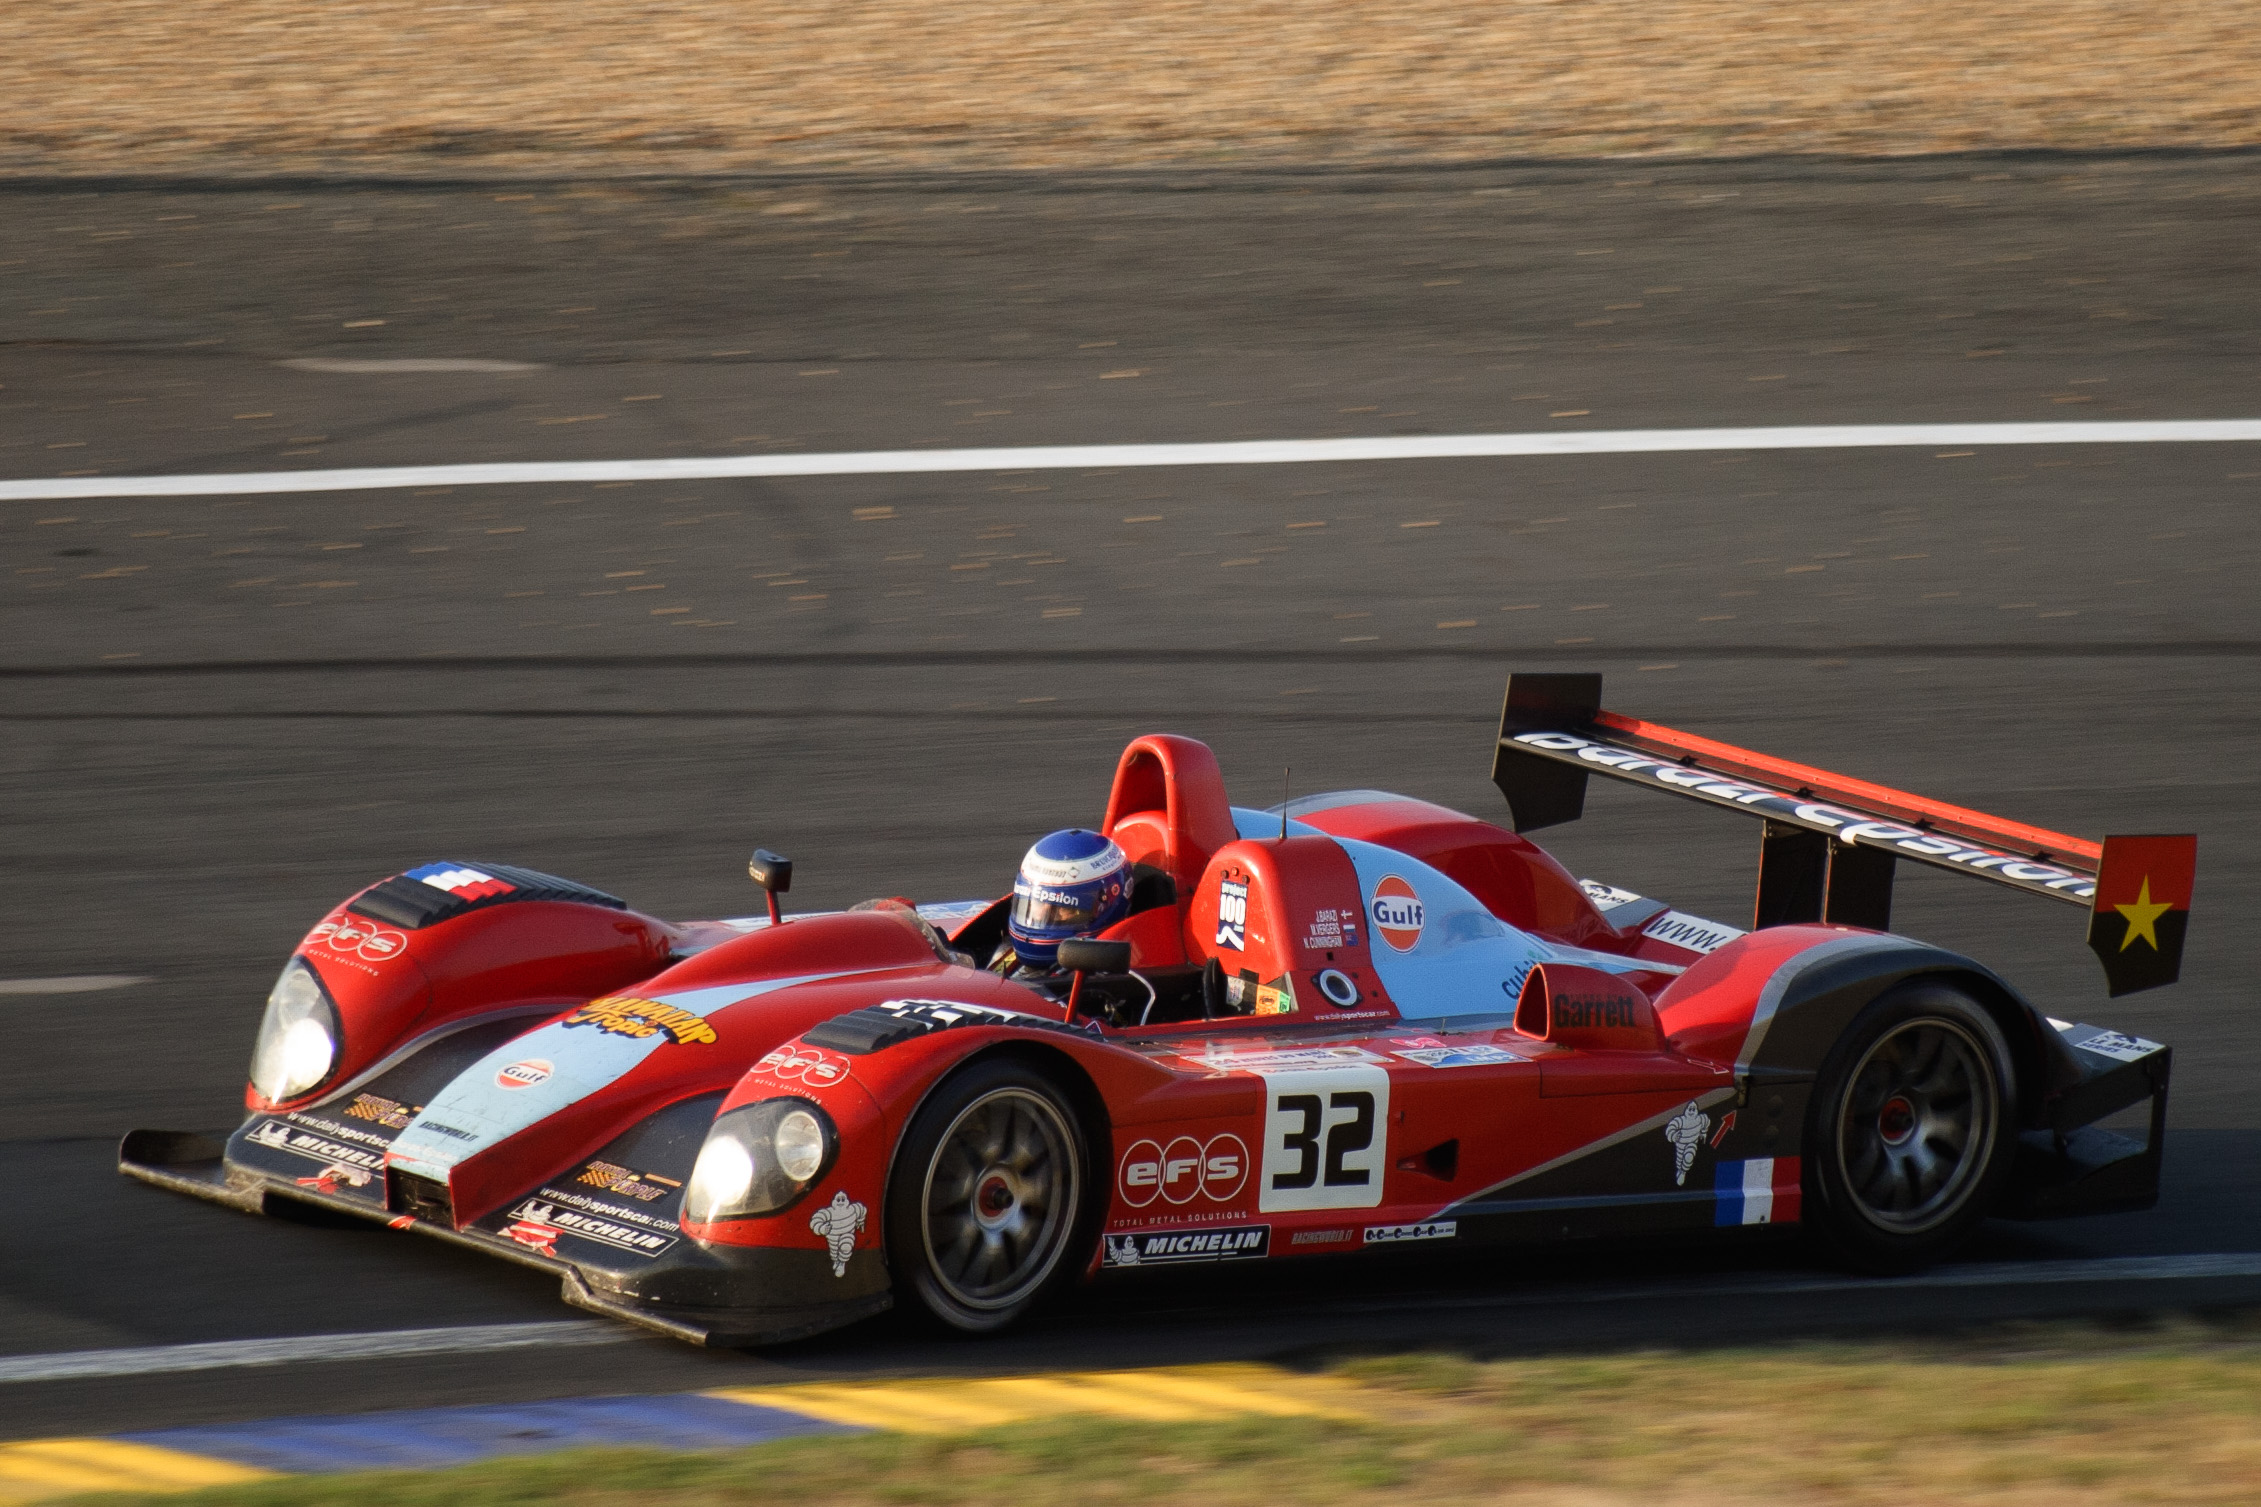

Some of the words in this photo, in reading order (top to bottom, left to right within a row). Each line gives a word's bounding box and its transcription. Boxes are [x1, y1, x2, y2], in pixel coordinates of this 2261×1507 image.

[1219, 894, 1246, 925] 100
[1373, 901, 1423, 926] Gulf
[1554, 993, 1636, 1028] Garrett
[503, 1066, 549, 1084] Gulf
[1272, 1091, 1375, 1190] 32
[538, 1187, 680, 1233] www.dailysportscar.com
[1188, 1211, 1248, 1221] SOLUTIONS
[553, 1212, 667, 1249] MICHELIN
[1144, 1231, 1263, 1255] MICHELIN
